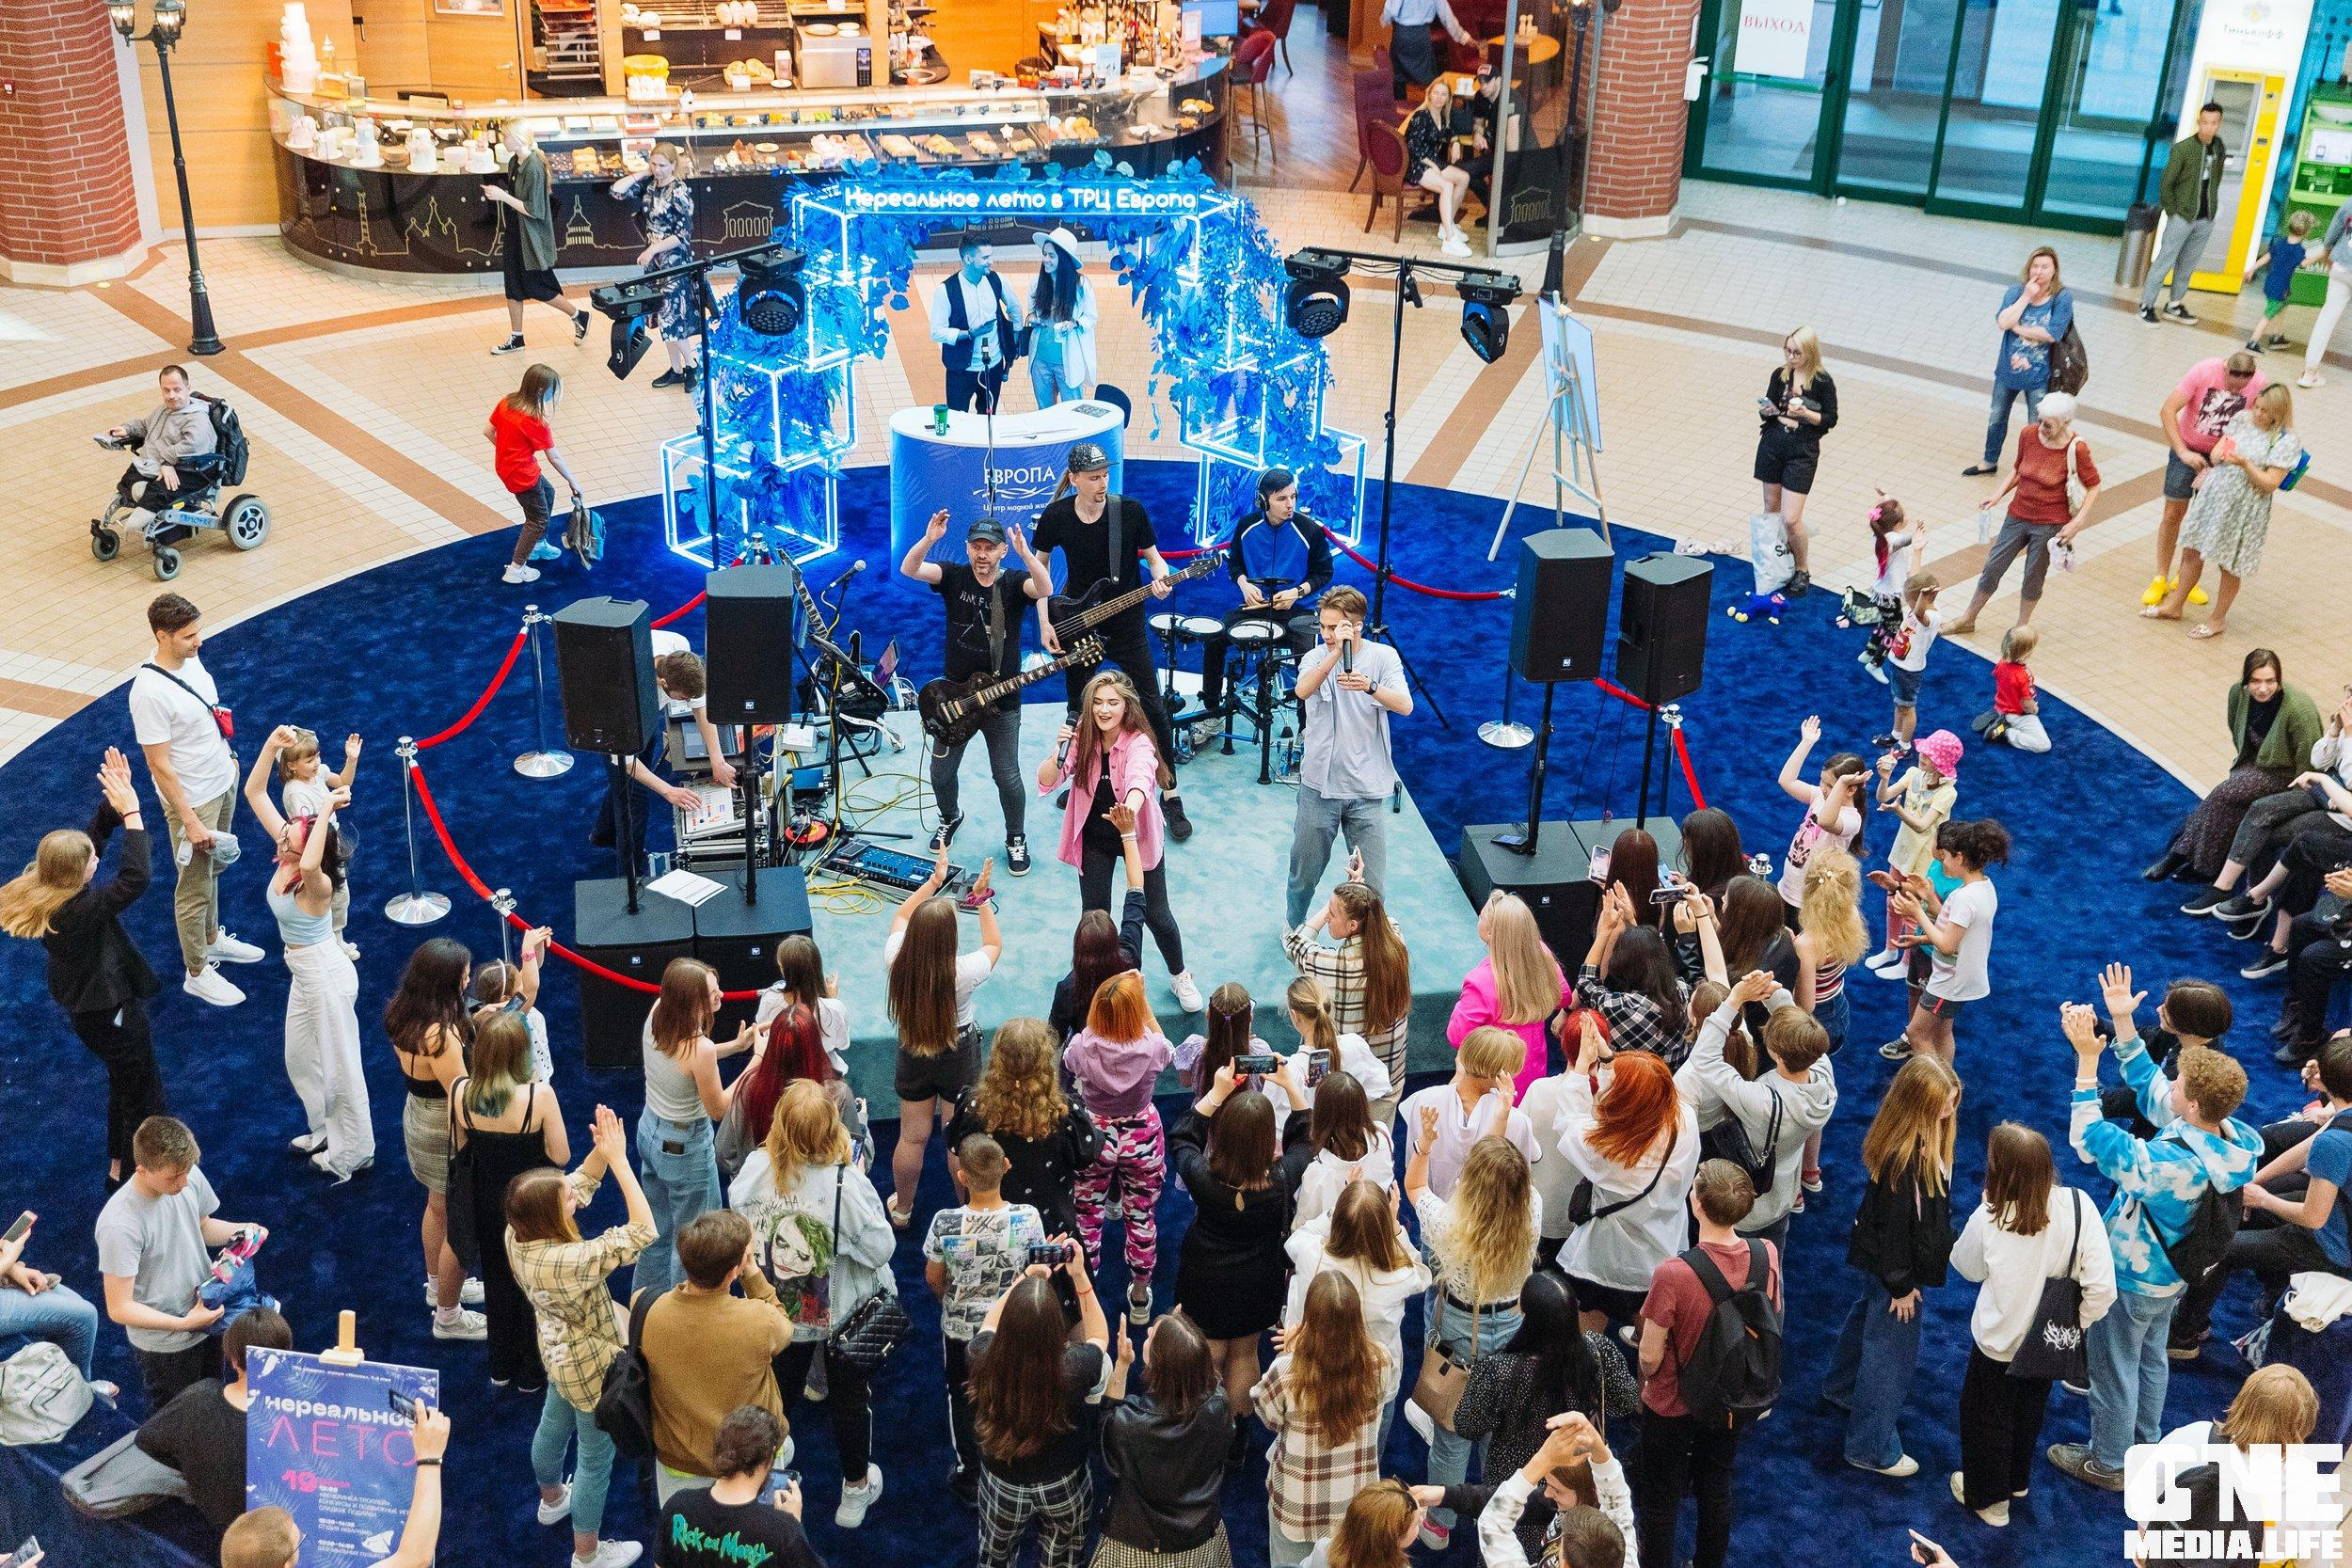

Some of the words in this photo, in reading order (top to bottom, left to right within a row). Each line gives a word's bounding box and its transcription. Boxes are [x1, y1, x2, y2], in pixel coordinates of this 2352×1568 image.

[1744, 15, 1806, 36] ВЫХОД
[845, 189, 980, 213] Нереальное
[986, 194, 1046, 209] лето
[1051, 191, 1063, 209] в
[1069, 188, 1111, 212] ТРЦ
[1117, 188, 1197, 214] Европа
[984, 466, 1056, 484] ЕВРОПА
[983, 503, 1006, 513] Цнтр
[1007, 502, 1033, 513] модной
[267, 1415, 417, 1467] ЛЕТО
[280, 1469, 317, 1494] 19
[673, 1513, 705, 1552] Rick
[720, 1530, 774, 1568] Morty
